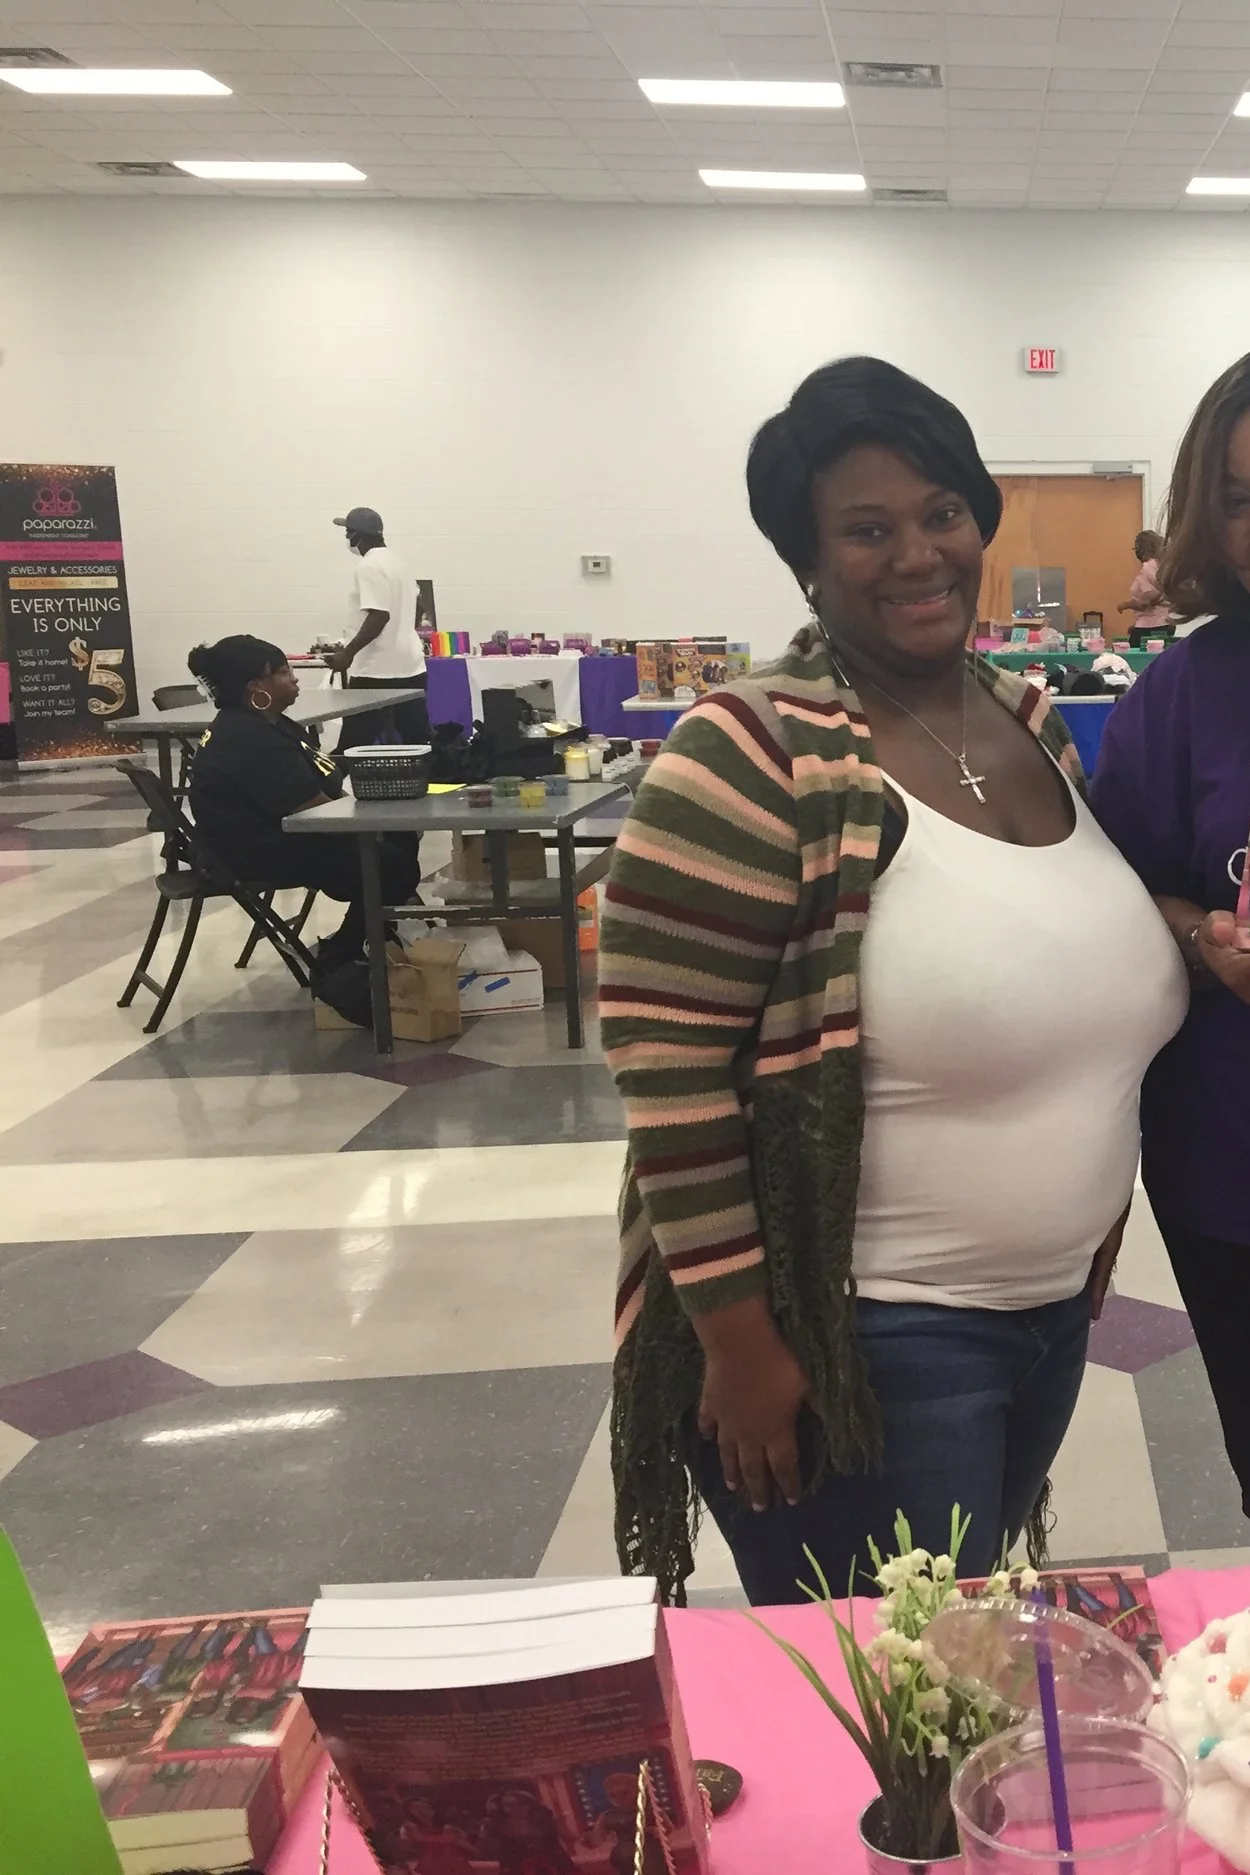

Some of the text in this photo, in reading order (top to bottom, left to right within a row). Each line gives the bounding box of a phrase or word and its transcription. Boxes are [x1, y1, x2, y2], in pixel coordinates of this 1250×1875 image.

[1030, 349, 1056, 369] EXIT
[22, 517, 94, 531] paparazzi
[8, 565, 118, 575] JEWELRY & ACCESSORIES
[10, 597, 121, 614] EVERYTHING
[33, 616, 102, 633] IS ONLY
[20, 674, 41, 682] LOVE
